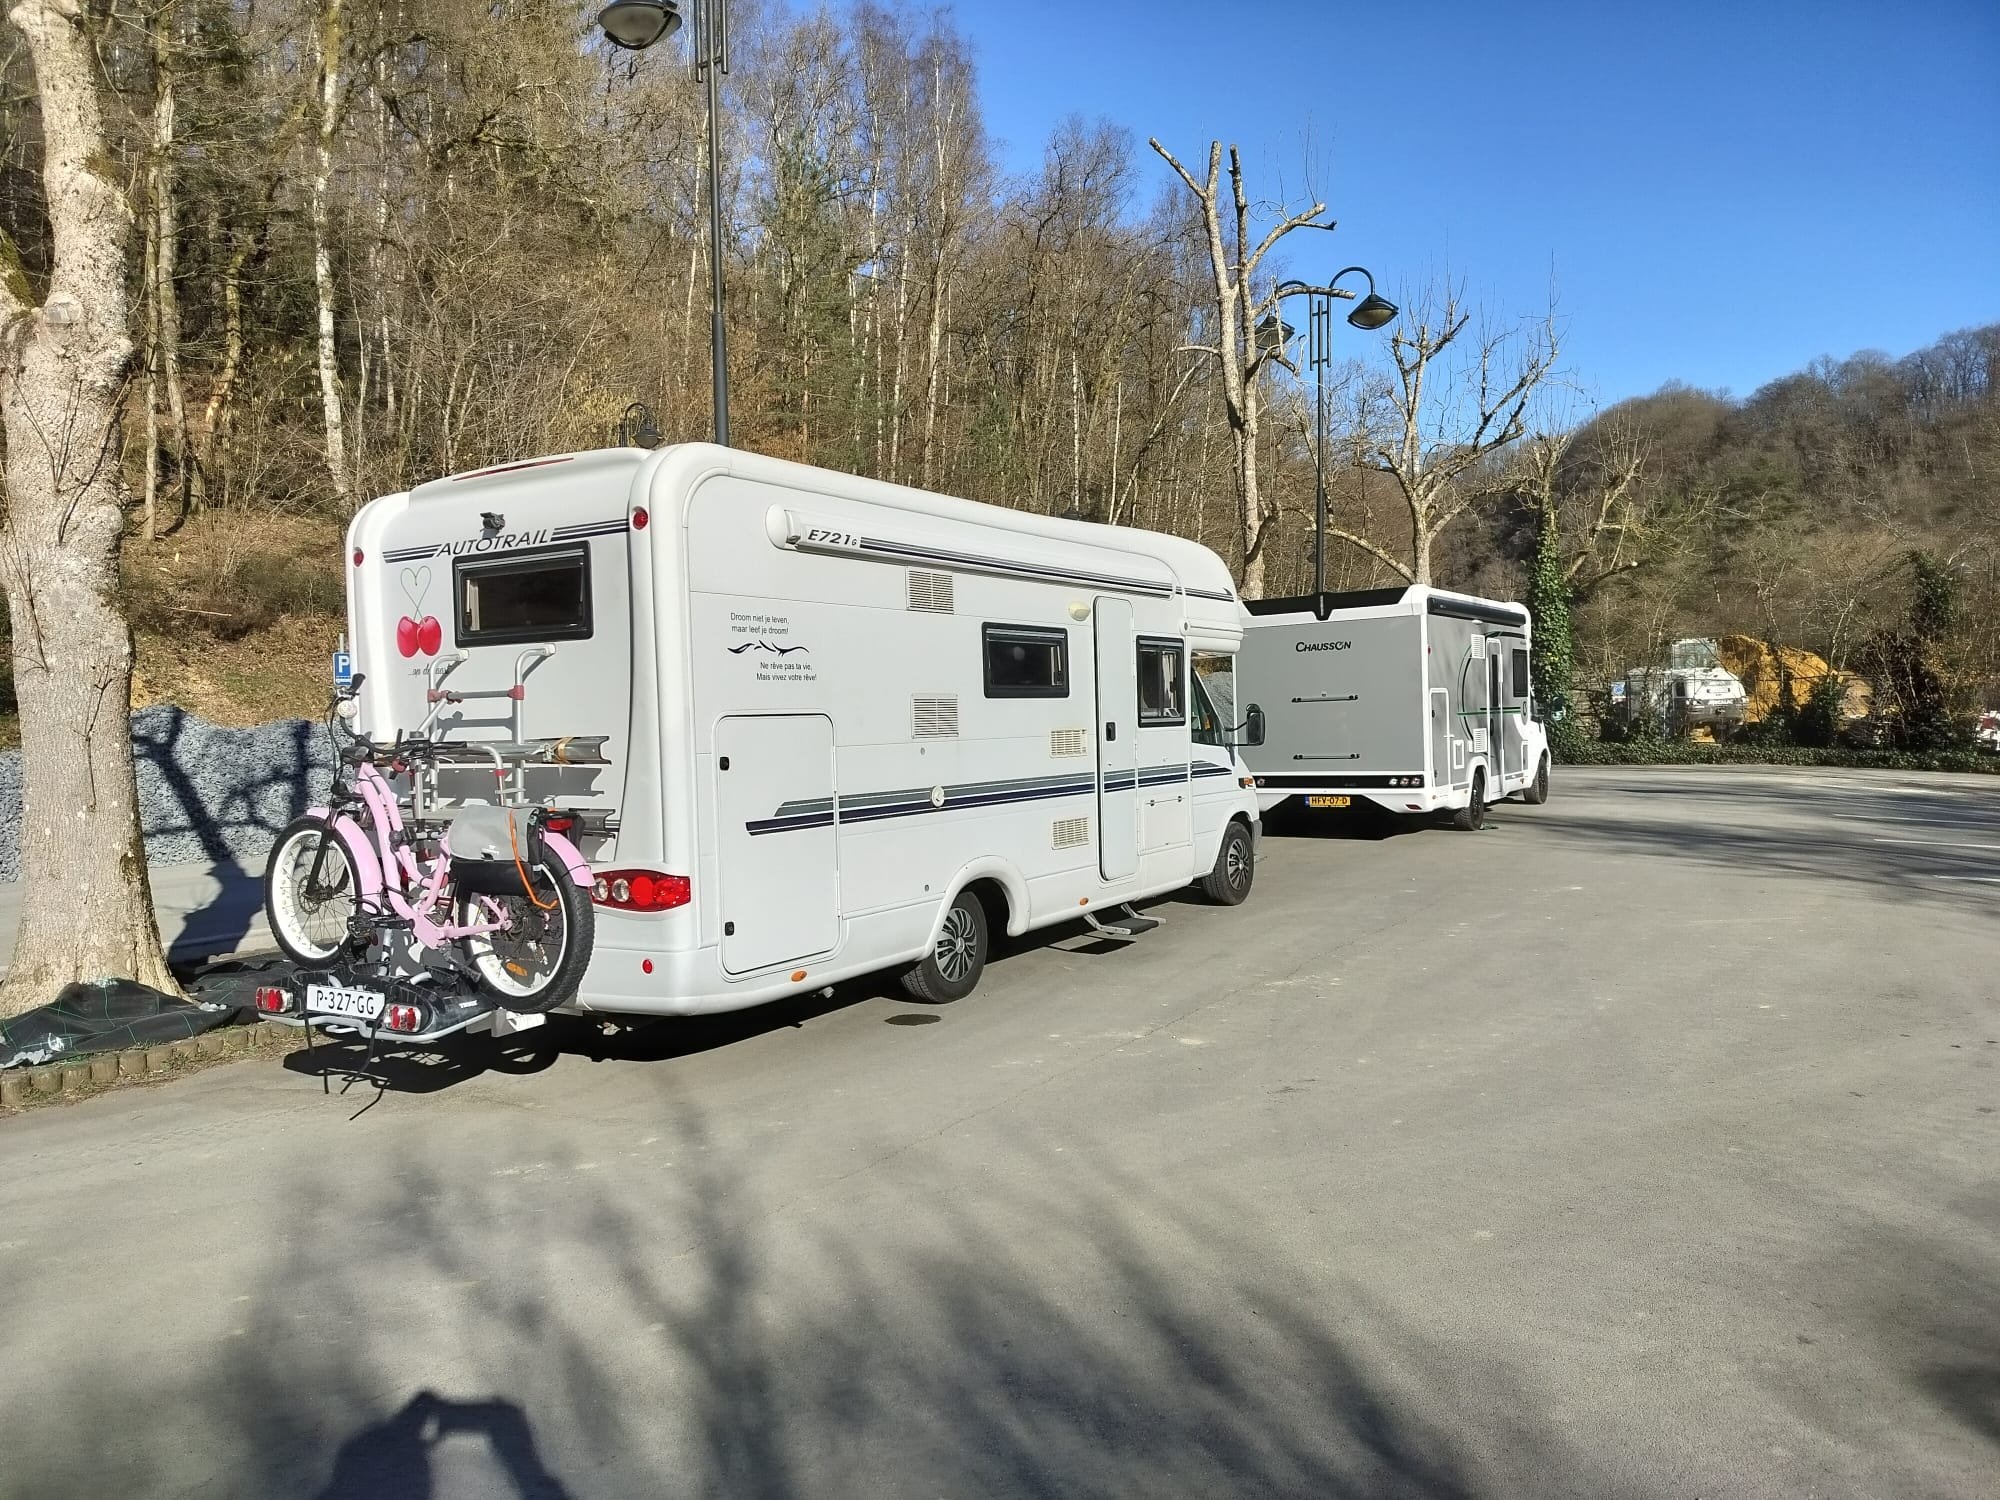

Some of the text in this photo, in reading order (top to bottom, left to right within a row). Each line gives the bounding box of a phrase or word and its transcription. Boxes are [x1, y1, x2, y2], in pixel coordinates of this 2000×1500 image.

[436, 529, 547, 557] AUTOTRAIL
[730, 612, 752, 622] Droom
[764, 616, 771, 624] je
[771, 615, 790, 624] leven,
[731, 625, 789, 635] maar leef je droom!
[338, 655, 350, 673] P
[760, 661, 769, 670] Ne
[770, 662, 783, 670] rêve
[784, 663, 795, 671] pas
[756, 672, 817, 681] Mais vivez votre rêve!
[316, 989, 374, 1015] P-327-GG
